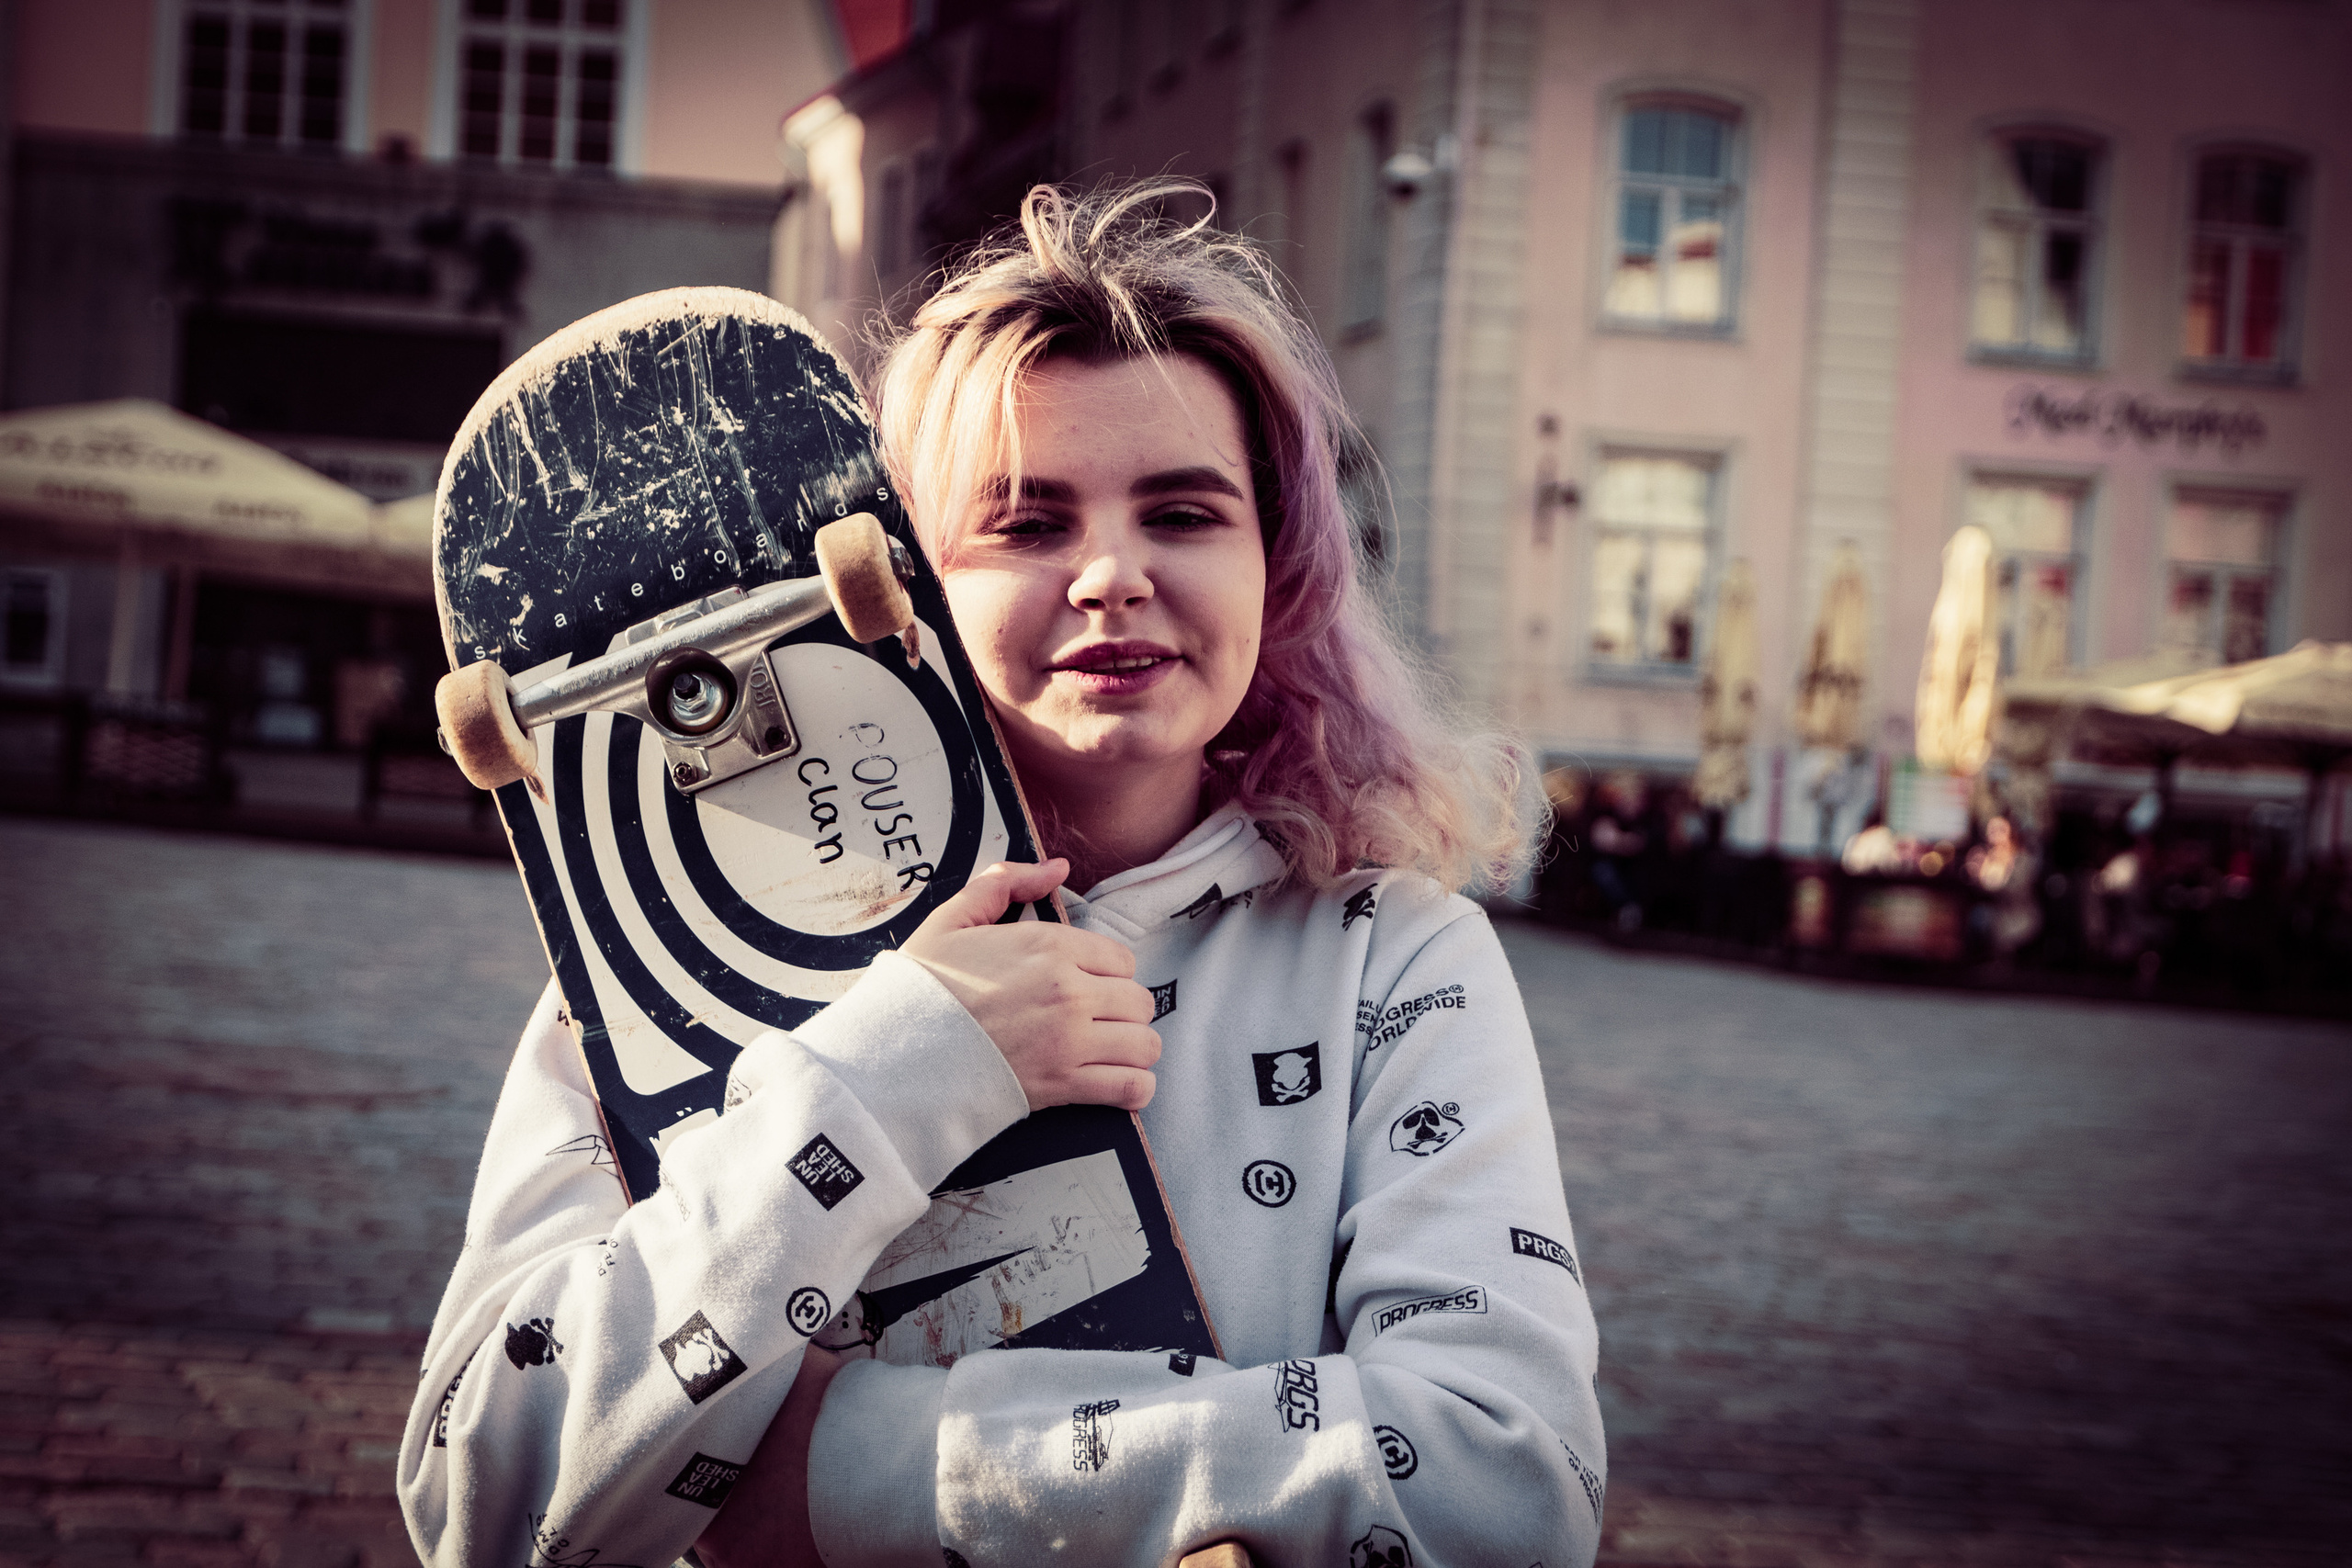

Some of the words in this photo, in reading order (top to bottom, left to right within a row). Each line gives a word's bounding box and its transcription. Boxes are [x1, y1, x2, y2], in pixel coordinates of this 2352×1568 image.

[1368, 996, 1466, 1051] ORLDWIDE
[1374, 987, 1449, 1032] OGRESS
[796, 1159, 820, 1185] UN
[808, 1151, 837, 1182] LEA
[816, 1144, 854, 1183] SHED
[1073, 1404, 1089, 1472] ROGRESS
[689, 1472, 720, 1489] LEA
[695, 1461, 740, 1482] SHED
[677, 1482, 704, 1497] UN
